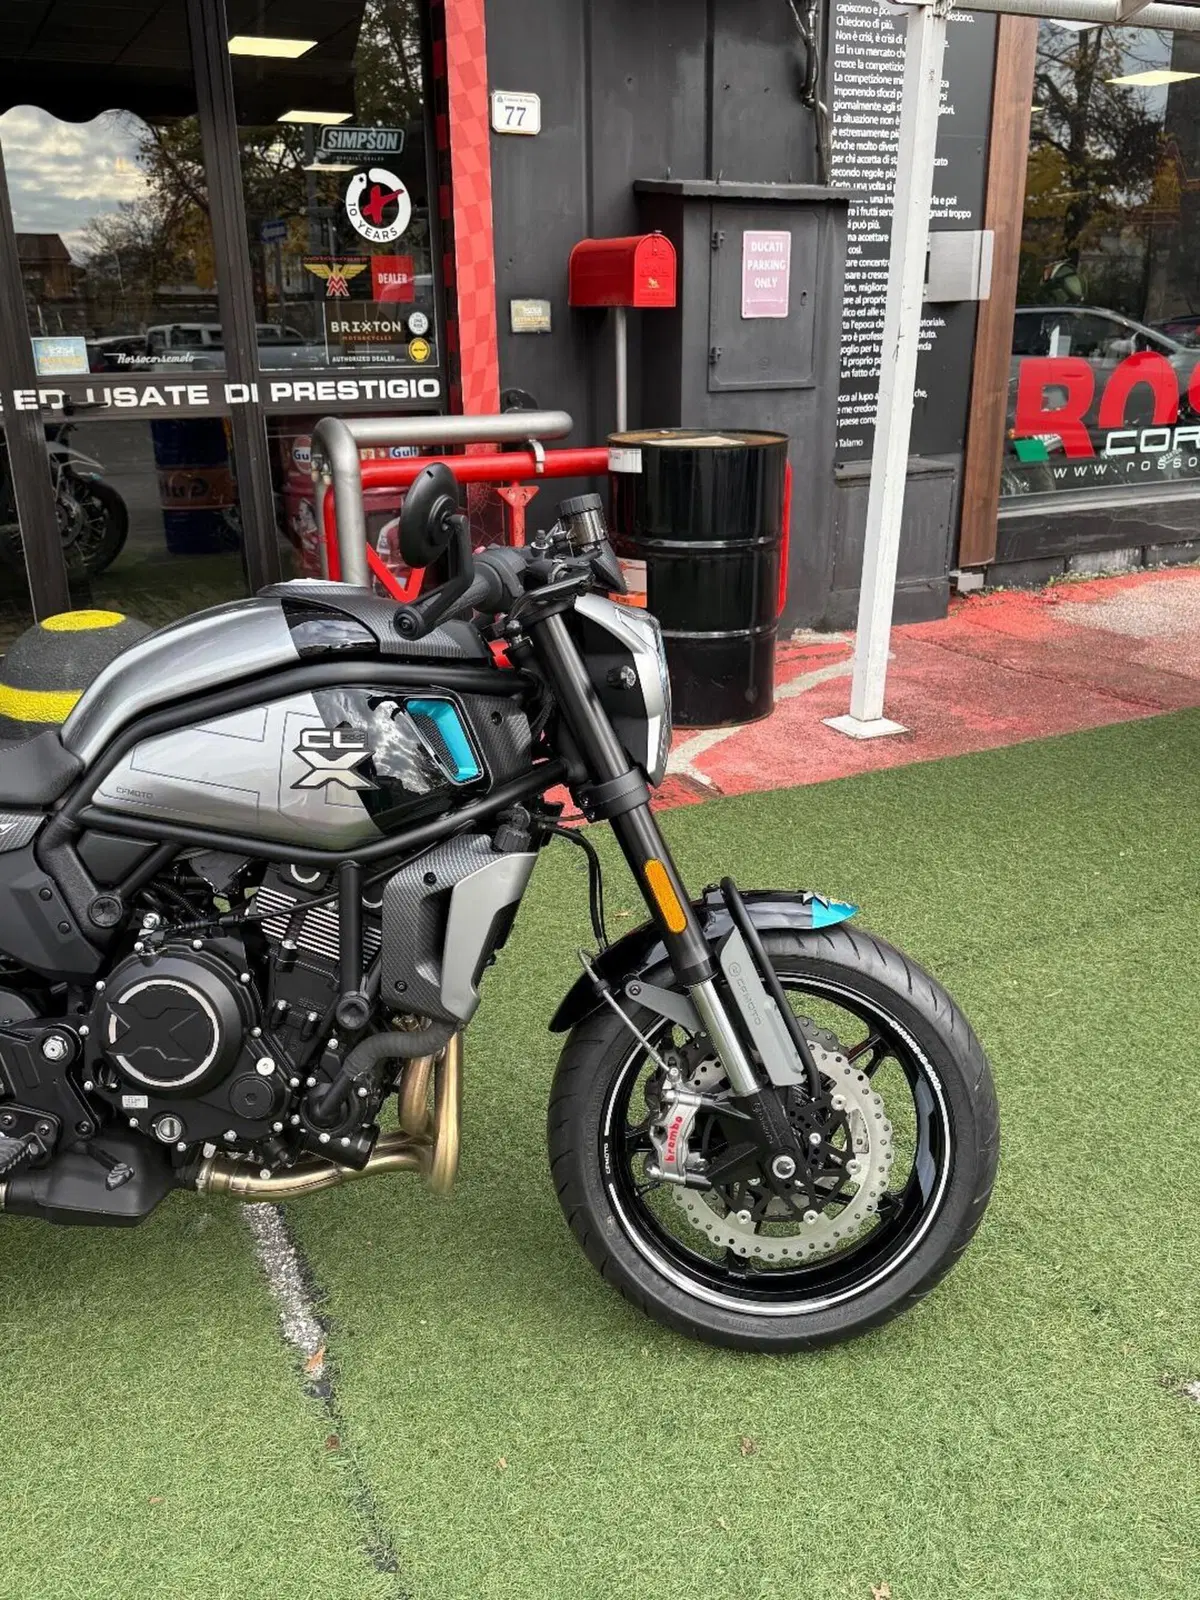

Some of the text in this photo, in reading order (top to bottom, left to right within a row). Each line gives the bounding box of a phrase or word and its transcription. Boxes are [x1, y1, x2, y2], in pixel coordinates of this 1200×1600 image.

[836, 16, 871, 28] Chiedono
[872, 18, 880, 28] di
[836, 30, 852, 40] Non
[896, 34, 902, 44] di
[835, 44, 845, 54] Ed
[846, 44, 854, 54] in
[866, 48, 896, 57] mercato
[834, 59, 904, 72] cresce la competizio
[834, 72, 843, 82] La
[844, 74, 892, 84] competizione
[834, 85, 876, 98] imponendo
[833, 99, 881, 111] giornalmente
[882, 102, 896, 114] agli
[505, 106, 526, 126] 77
[833, 113, 841, 122] La
[842, 114, 879, 124] situazione
[880, 116, 894, 124] non
[838, 128, 890, 138] estremamente
[327, 131, 398, 150] SIMPSON
[832, 140, 855, 150] Anche
[856, 140, 878, 150] molto
[832, 155, 844, 164] per
[845, 153, 856, 164] chi
[857, 155, 881, 164] accetta
[882, 154, 890, 164] di
[831, 166, 860, 176] secondo
[862, 168, 884, 180] regole
[869, 181, 886, 190] volta
[886, 182, 892, 190] si
[870, 196, 883, 204] una
[946, 196, 957, 206] poi
[860, 206, 878, 216] frutti
[949, 210, 972, 220] troppo
[348, 202, 398, 240] 10 YEARS
[852, 220, 866, 230] può
[858, 233, 889, 242] accettare
[751, 241, 783, 252] DUCATI
[747, 260, 786, 270] PARKING
[378, 274, 408, 284] DEALER
[862, 272, 866, 280] a
[754, 277, 778, 288] ONLY
[855, 294, 862, 304] al
[856, 308, 866, 316] ed
[331, 321, 402, 333] BRIXTON
[860, 346, 872, 354] per
[873, 344, 880, 352] la
[848, 356, 874, 367] proprio
[852, 368, 868, 378] fatto
[86, 385, 210, 408] USATE
[224, 383, 259, 404] DI
[270, 378, 440, 402] PRESTIGIO
[850, 392, 858, 402] al
[858, 392, 874, 402] lupo
[842, 406, 852, 414] me
[840, 418, 860, 428] paese
[839, 438, 864, 448] Talamo
[294, 450, 310, 460] Gu
[116, 786, 154, 799] CFMOTO
[664, 1116, 683, 1161] brembo
